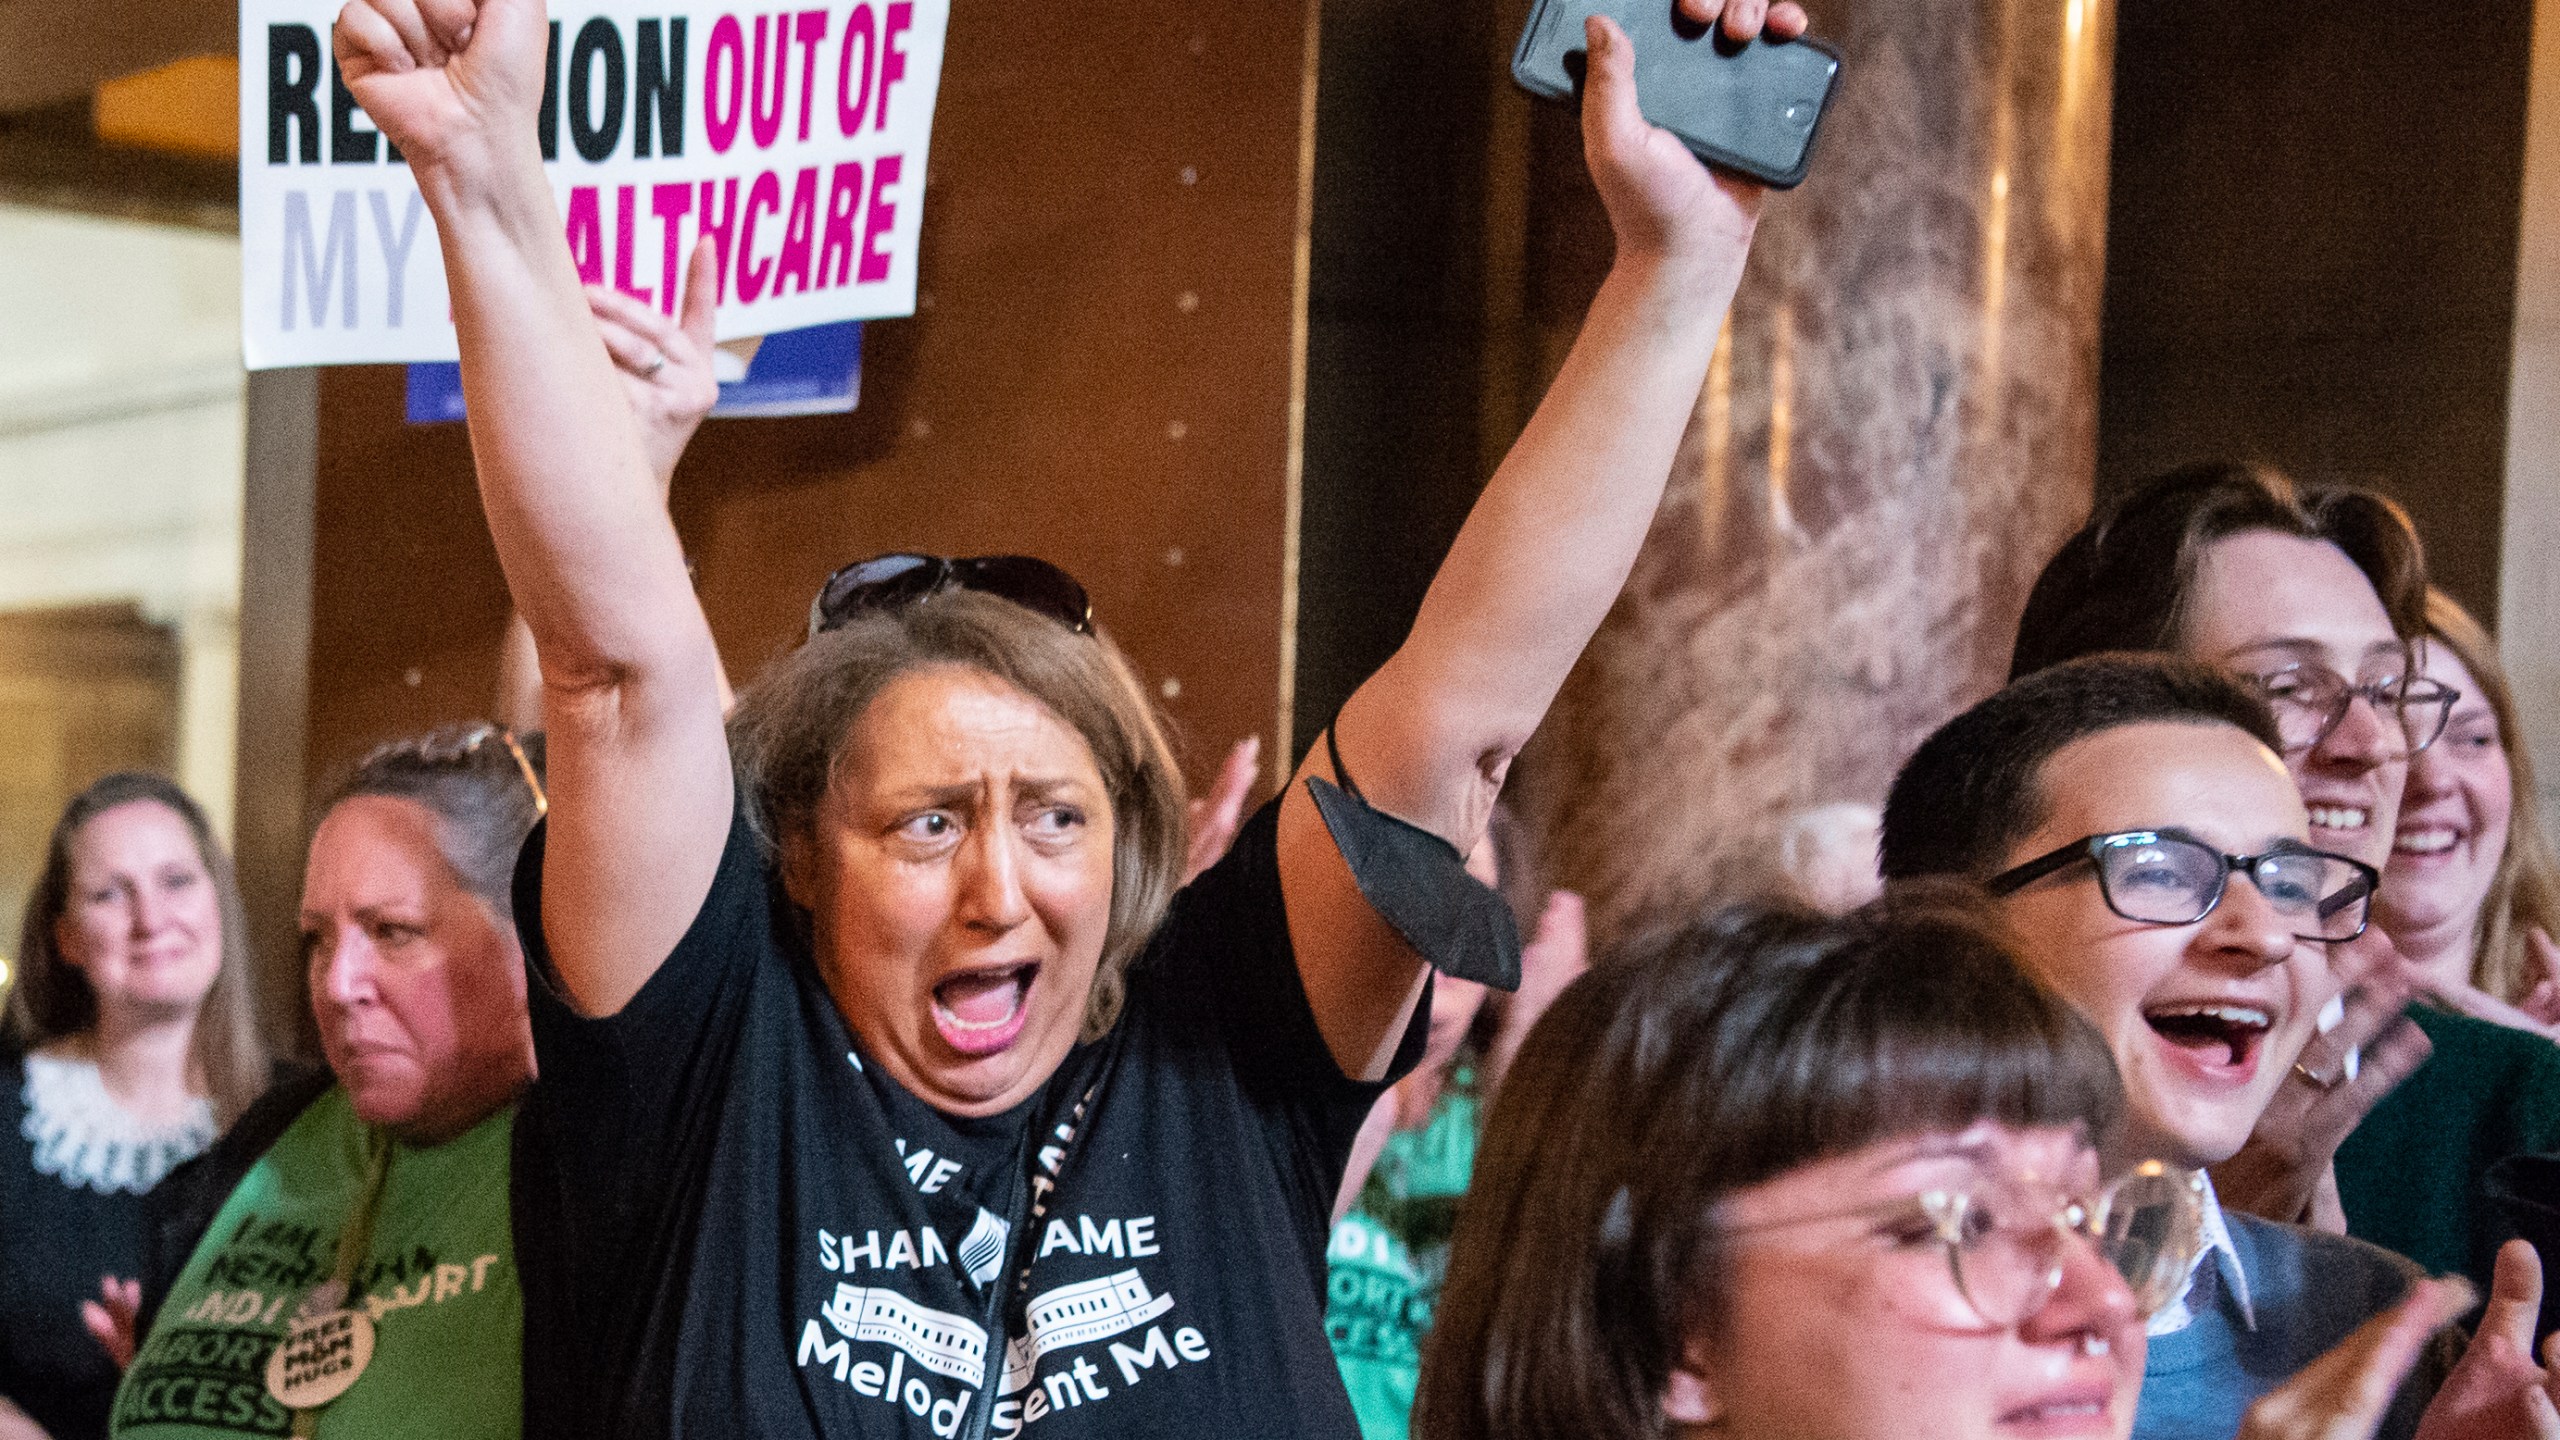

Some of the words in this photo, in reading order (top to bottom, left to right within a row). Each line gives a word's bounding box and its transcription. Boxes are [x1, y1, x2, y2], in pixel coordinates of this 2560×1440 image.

[703, 10, 827, 153] OUT
[837, 1, 913, 138] OF
[280, 190, 426, 332] MY
[284, 1315, 352, 1351] FREE
[284, 1354, 354, 1391] HUGS
[797, 1318, 972, 1440] Melod
[989, 1355, 1109, 1440] Sent
[1109, 1322, 1212, 1386] Me
